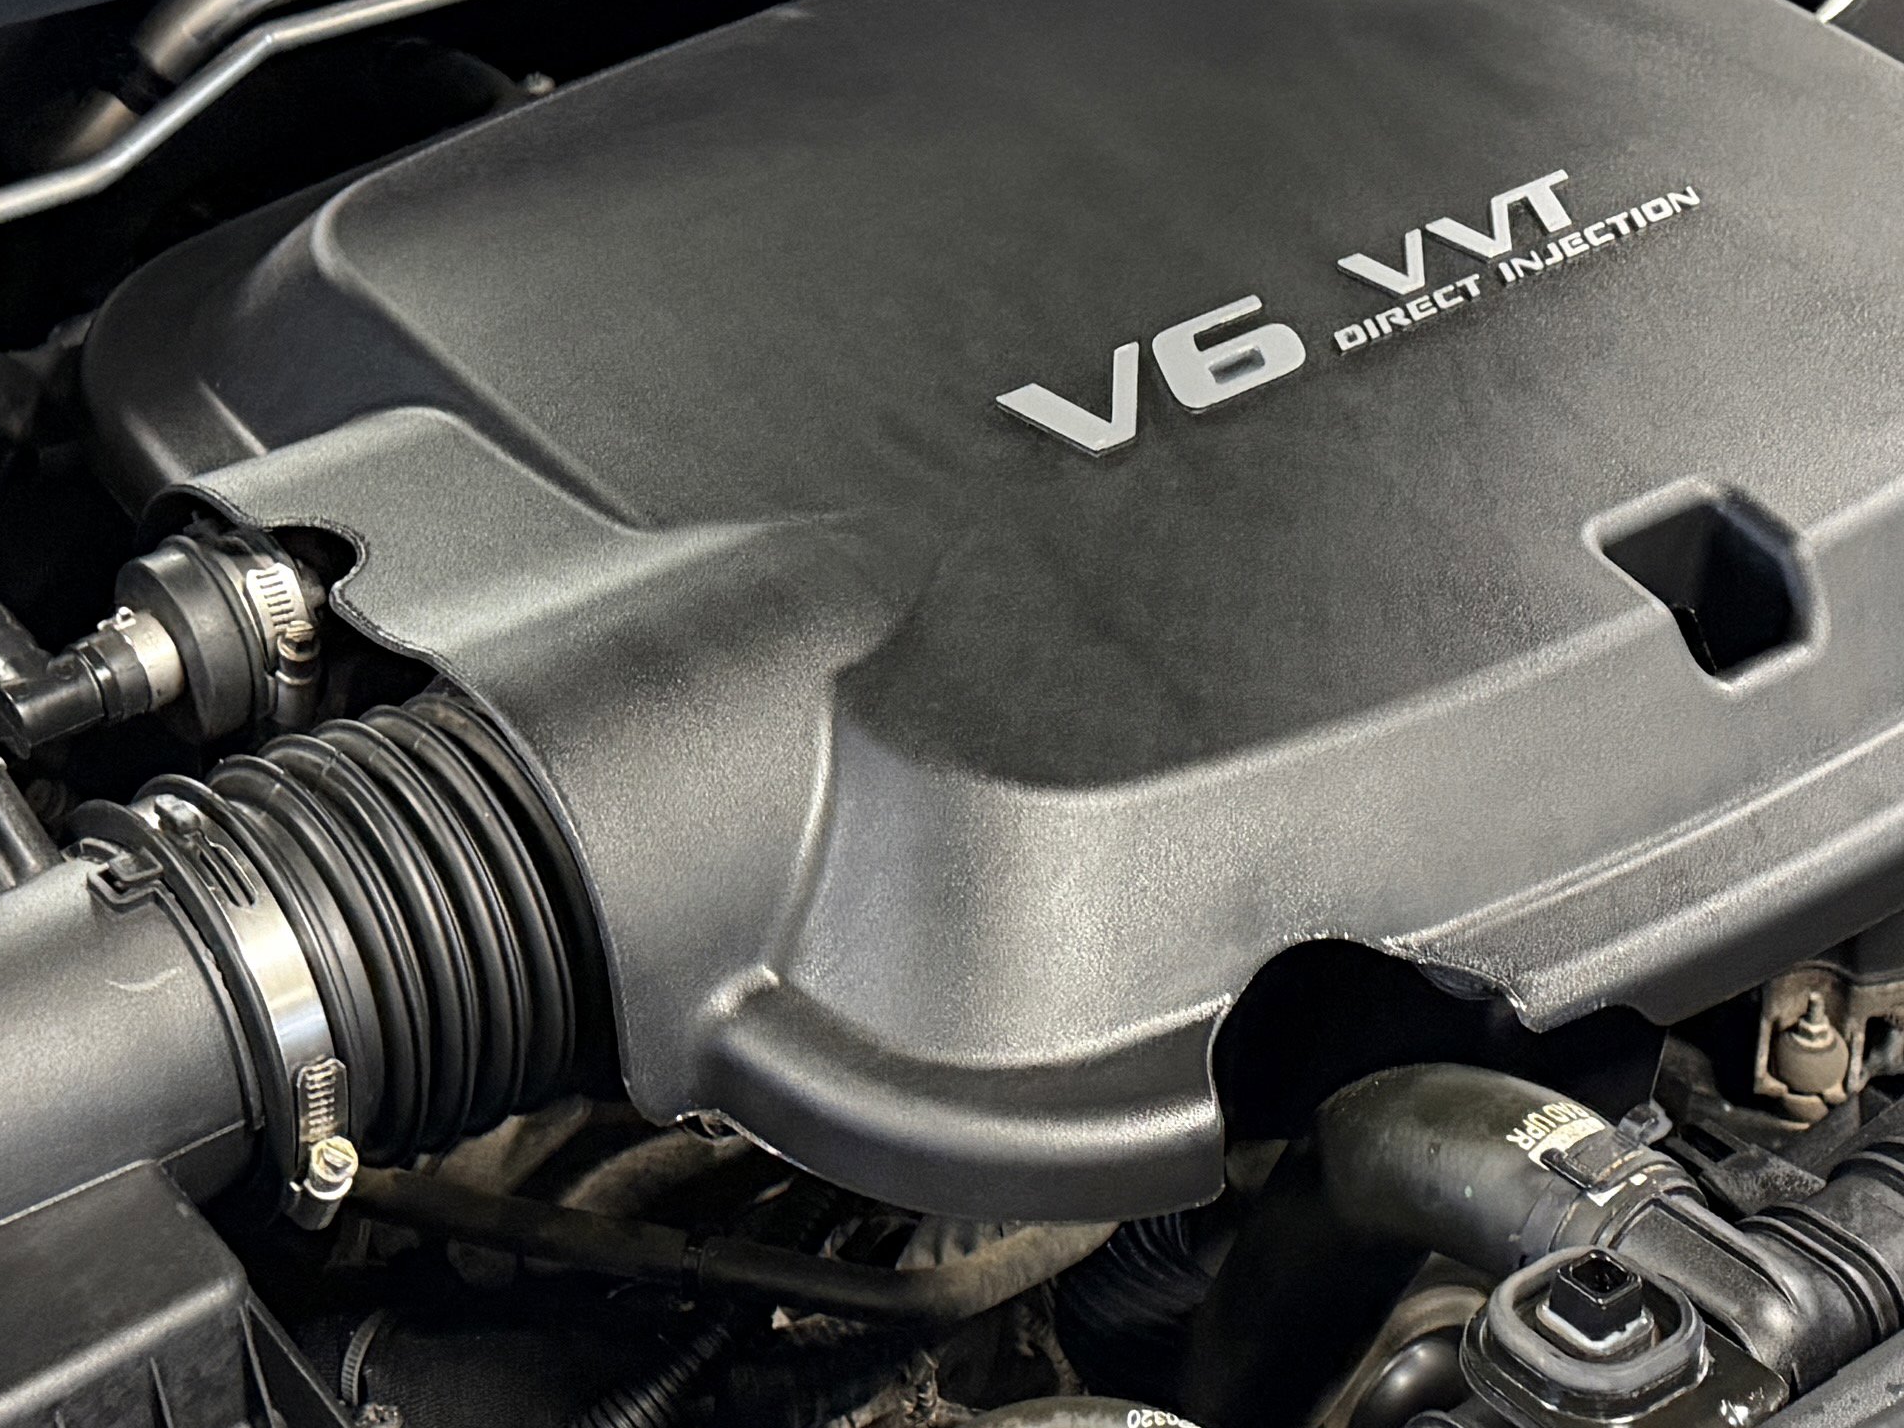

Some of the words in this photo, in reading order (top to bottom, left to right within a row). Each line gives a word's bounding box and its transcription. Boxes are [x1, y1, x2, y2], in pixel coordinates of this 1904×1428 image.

[995, 294, 1307, 458] V6
[1336, 168, 1570, 297] VVT
[1332, 272, 1485, 354] DIRECT
[1497, 185, 1702, 287] INJECTION
[1506, 1112, 1557, 1151] UPR
[1542, 1102, 1590, 1125] RAD
